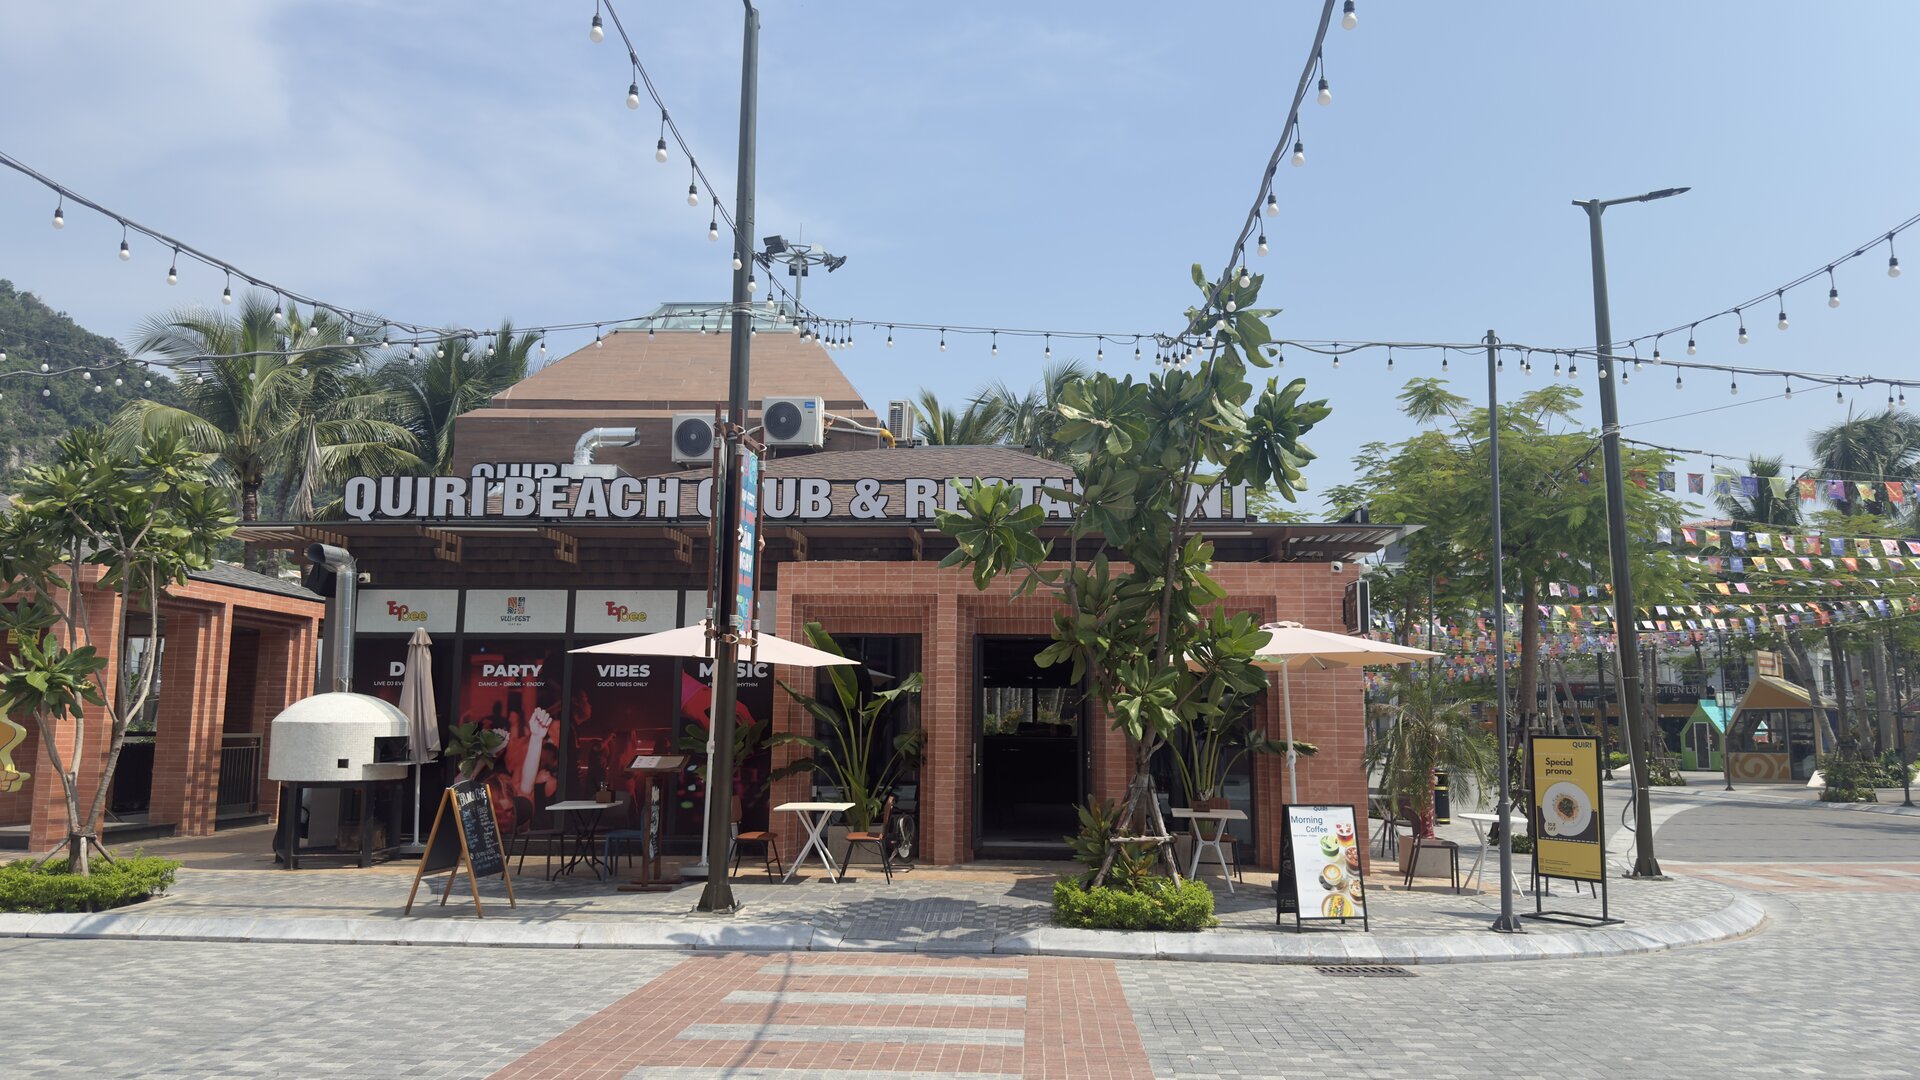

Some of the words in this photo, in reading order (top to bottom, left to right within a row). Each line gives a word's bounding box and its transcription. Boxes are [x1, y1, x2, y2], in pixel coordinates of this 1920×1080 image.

[343, 475, 487, 522] QUIRI
[503, 476, 680, 518] BEACH
[697, 477, 832, 519] UB
[849, 477, 890, 519] &
[482, 664, 543, 677] PARTY
[596, 664, 651, 678] VIBES
[699, 662, 769, 679] MSIC
[1572, 741, 1592, 749] QUIRI
[1545, 757, 1573, 767] Special
[1545, 767, 1572, 776] promo
[1291, 816, 1322, 825] Morning
